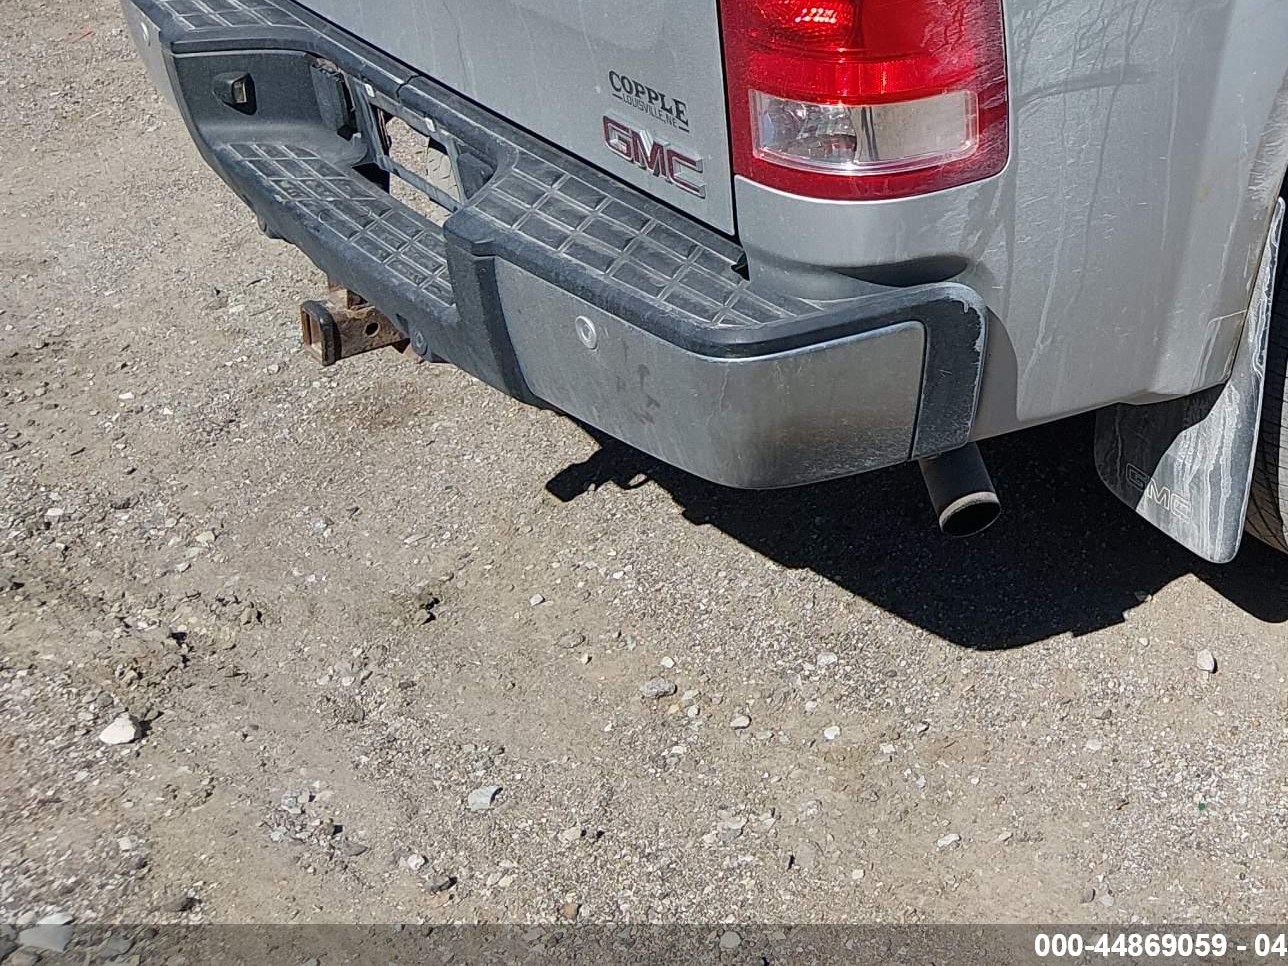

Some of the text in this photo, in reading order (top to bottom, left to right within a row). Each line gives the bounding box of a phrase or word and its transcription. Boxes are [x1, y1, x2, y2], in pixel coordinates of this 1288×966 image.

[608, 70, 689, 127] COPPLE
[603, 115, 706, 199] GMC
[1126, 463, 1192, 523] GMC
